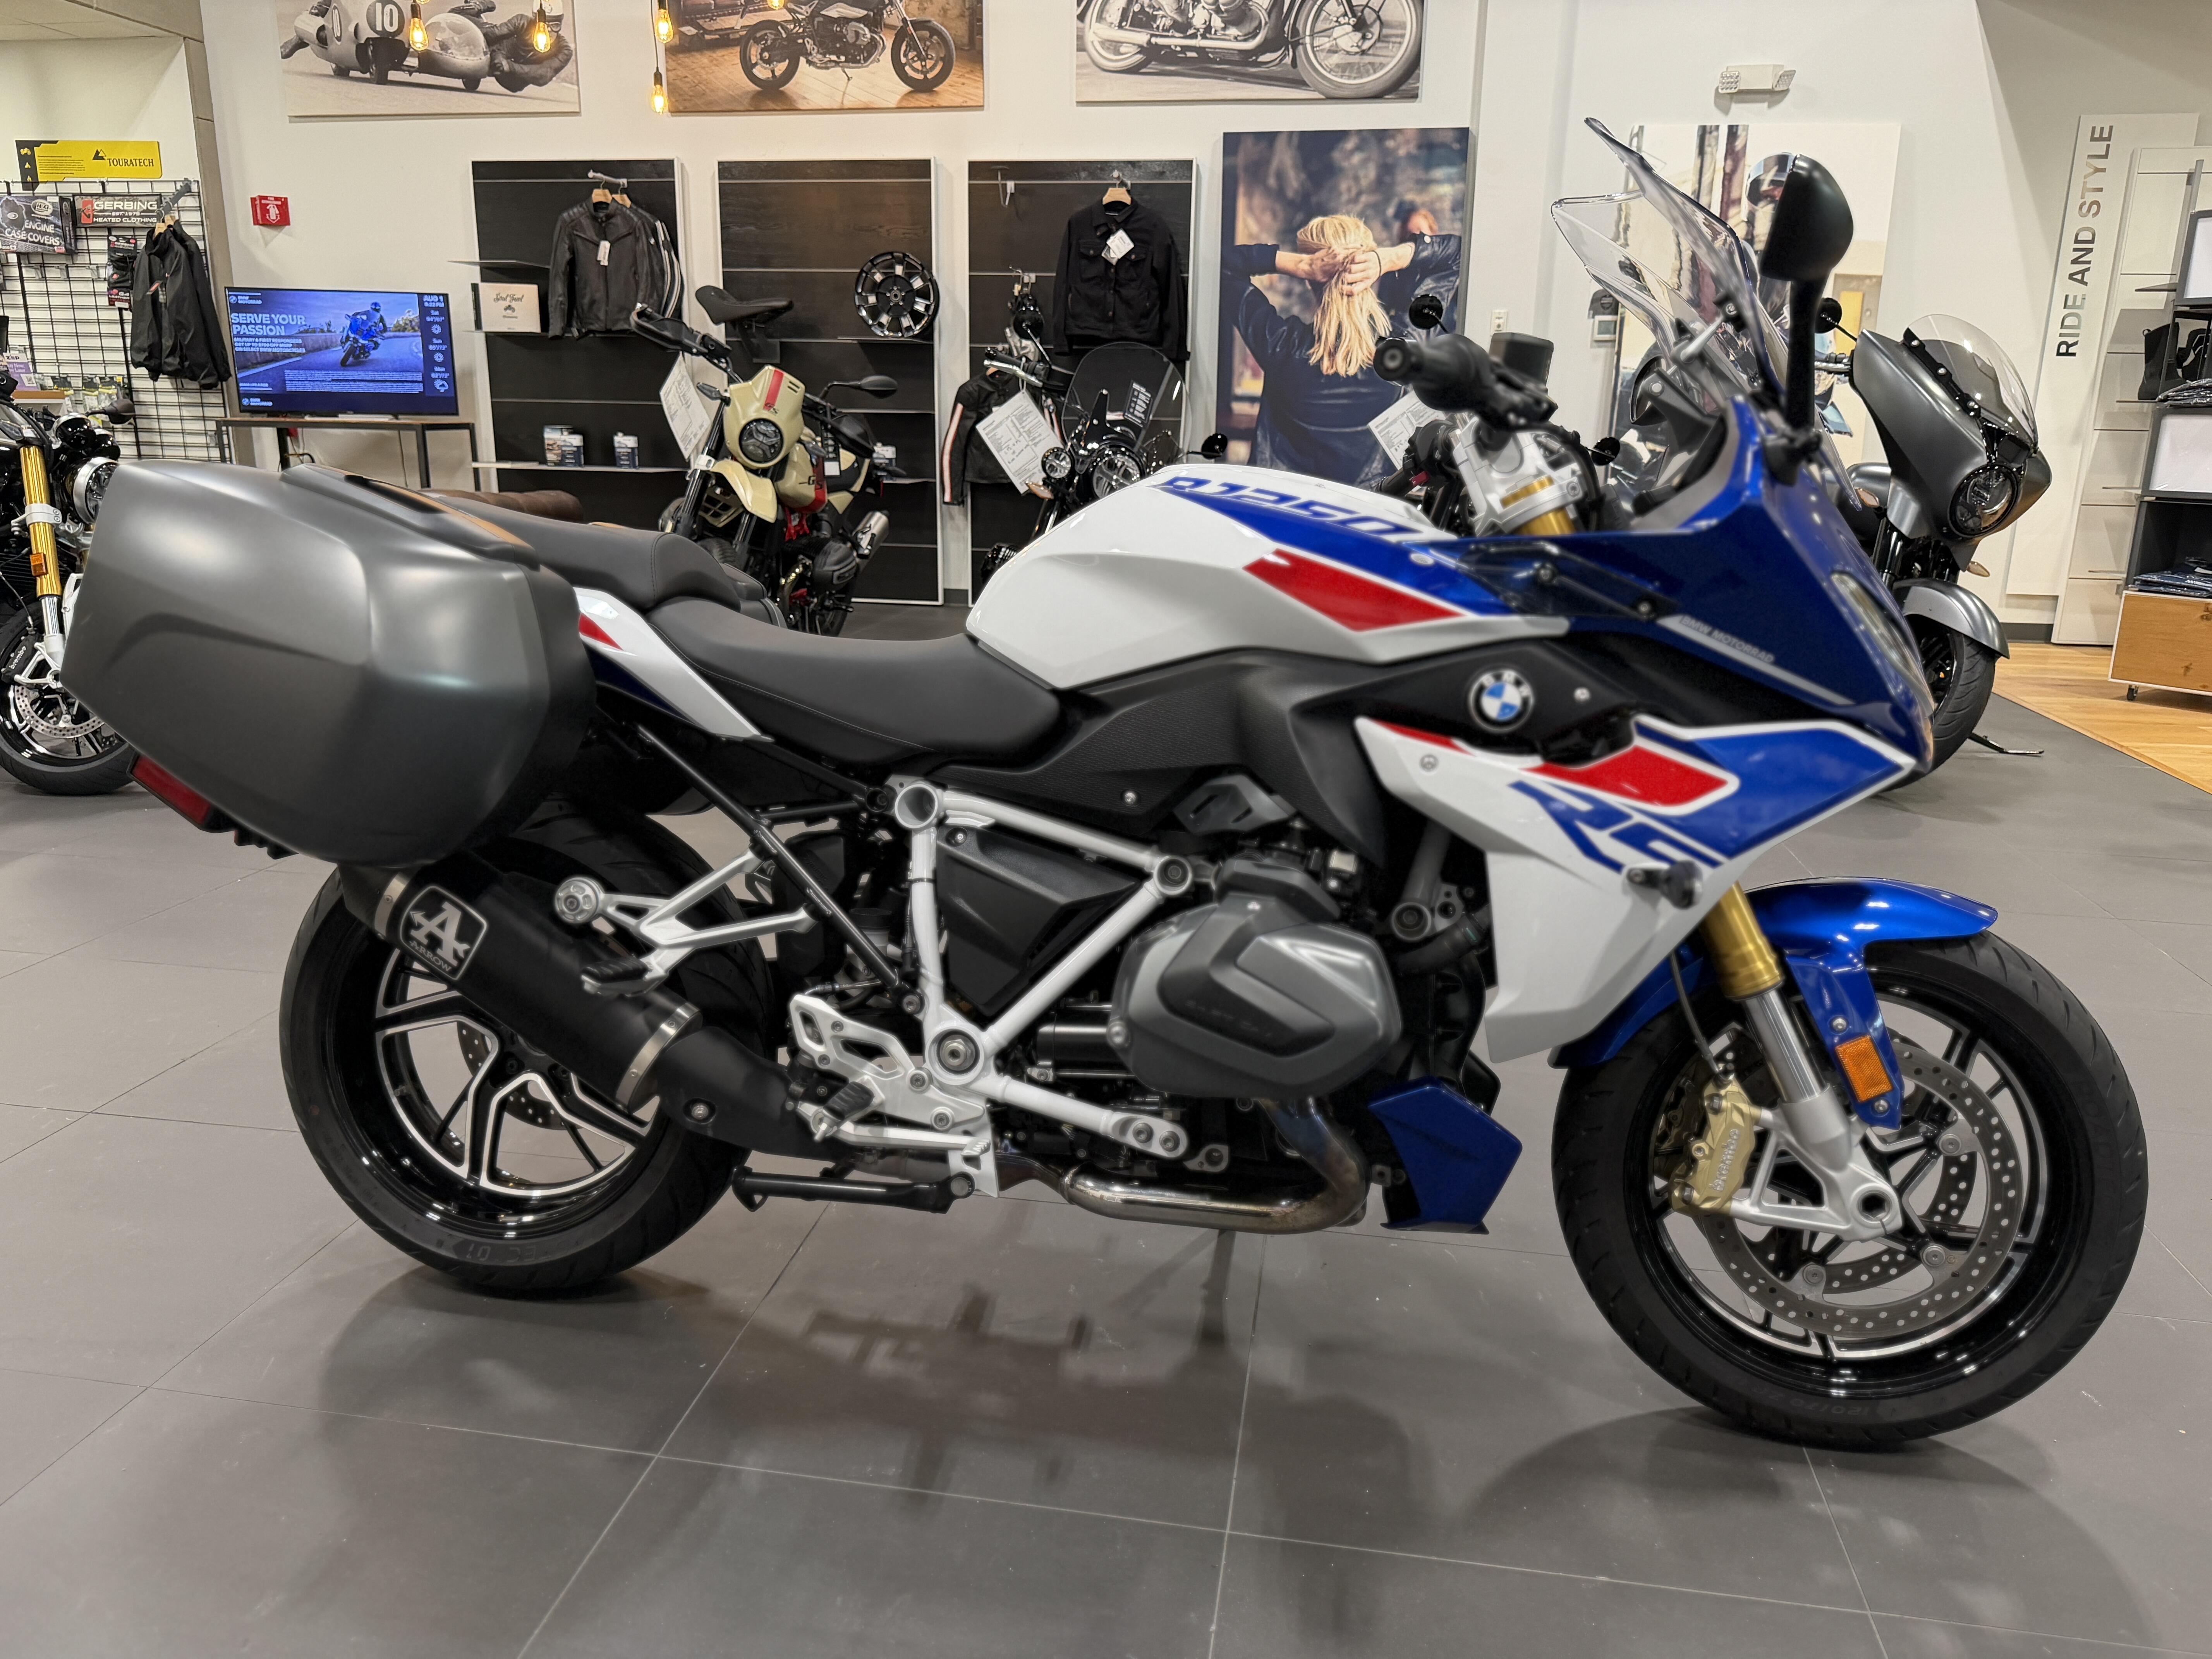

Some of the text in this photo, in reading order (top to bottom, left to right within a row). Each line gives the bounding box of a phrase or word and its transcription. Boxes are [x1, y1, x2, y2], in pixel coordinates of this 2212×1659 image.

[332, 9, 341, 37] 10
[376, 2, 398, 32] 10
[107, 158, 154, 167] TOURATECH
[94, 201, 157, 210] GERBING
[5, 228, 26, 240] CASE
[28, 232, 60, 246] COVERS
[24, 220, 55, 233] ENGINE
[2056, 125, 2113, 357] RIDE AND STYLE
[231, 313, 306, 325] SERVE YOUR
[233, 325, 285, 335] PASSION
[1681, 615, 1775, 663] BMW MOTORRAD
[9, 646, 26, 670] brembo
[1481, 669, 1531, 697] BMW
[409, 940, 452, 971] ARROW
[1708, 1129, 1740, 1192] brembo
